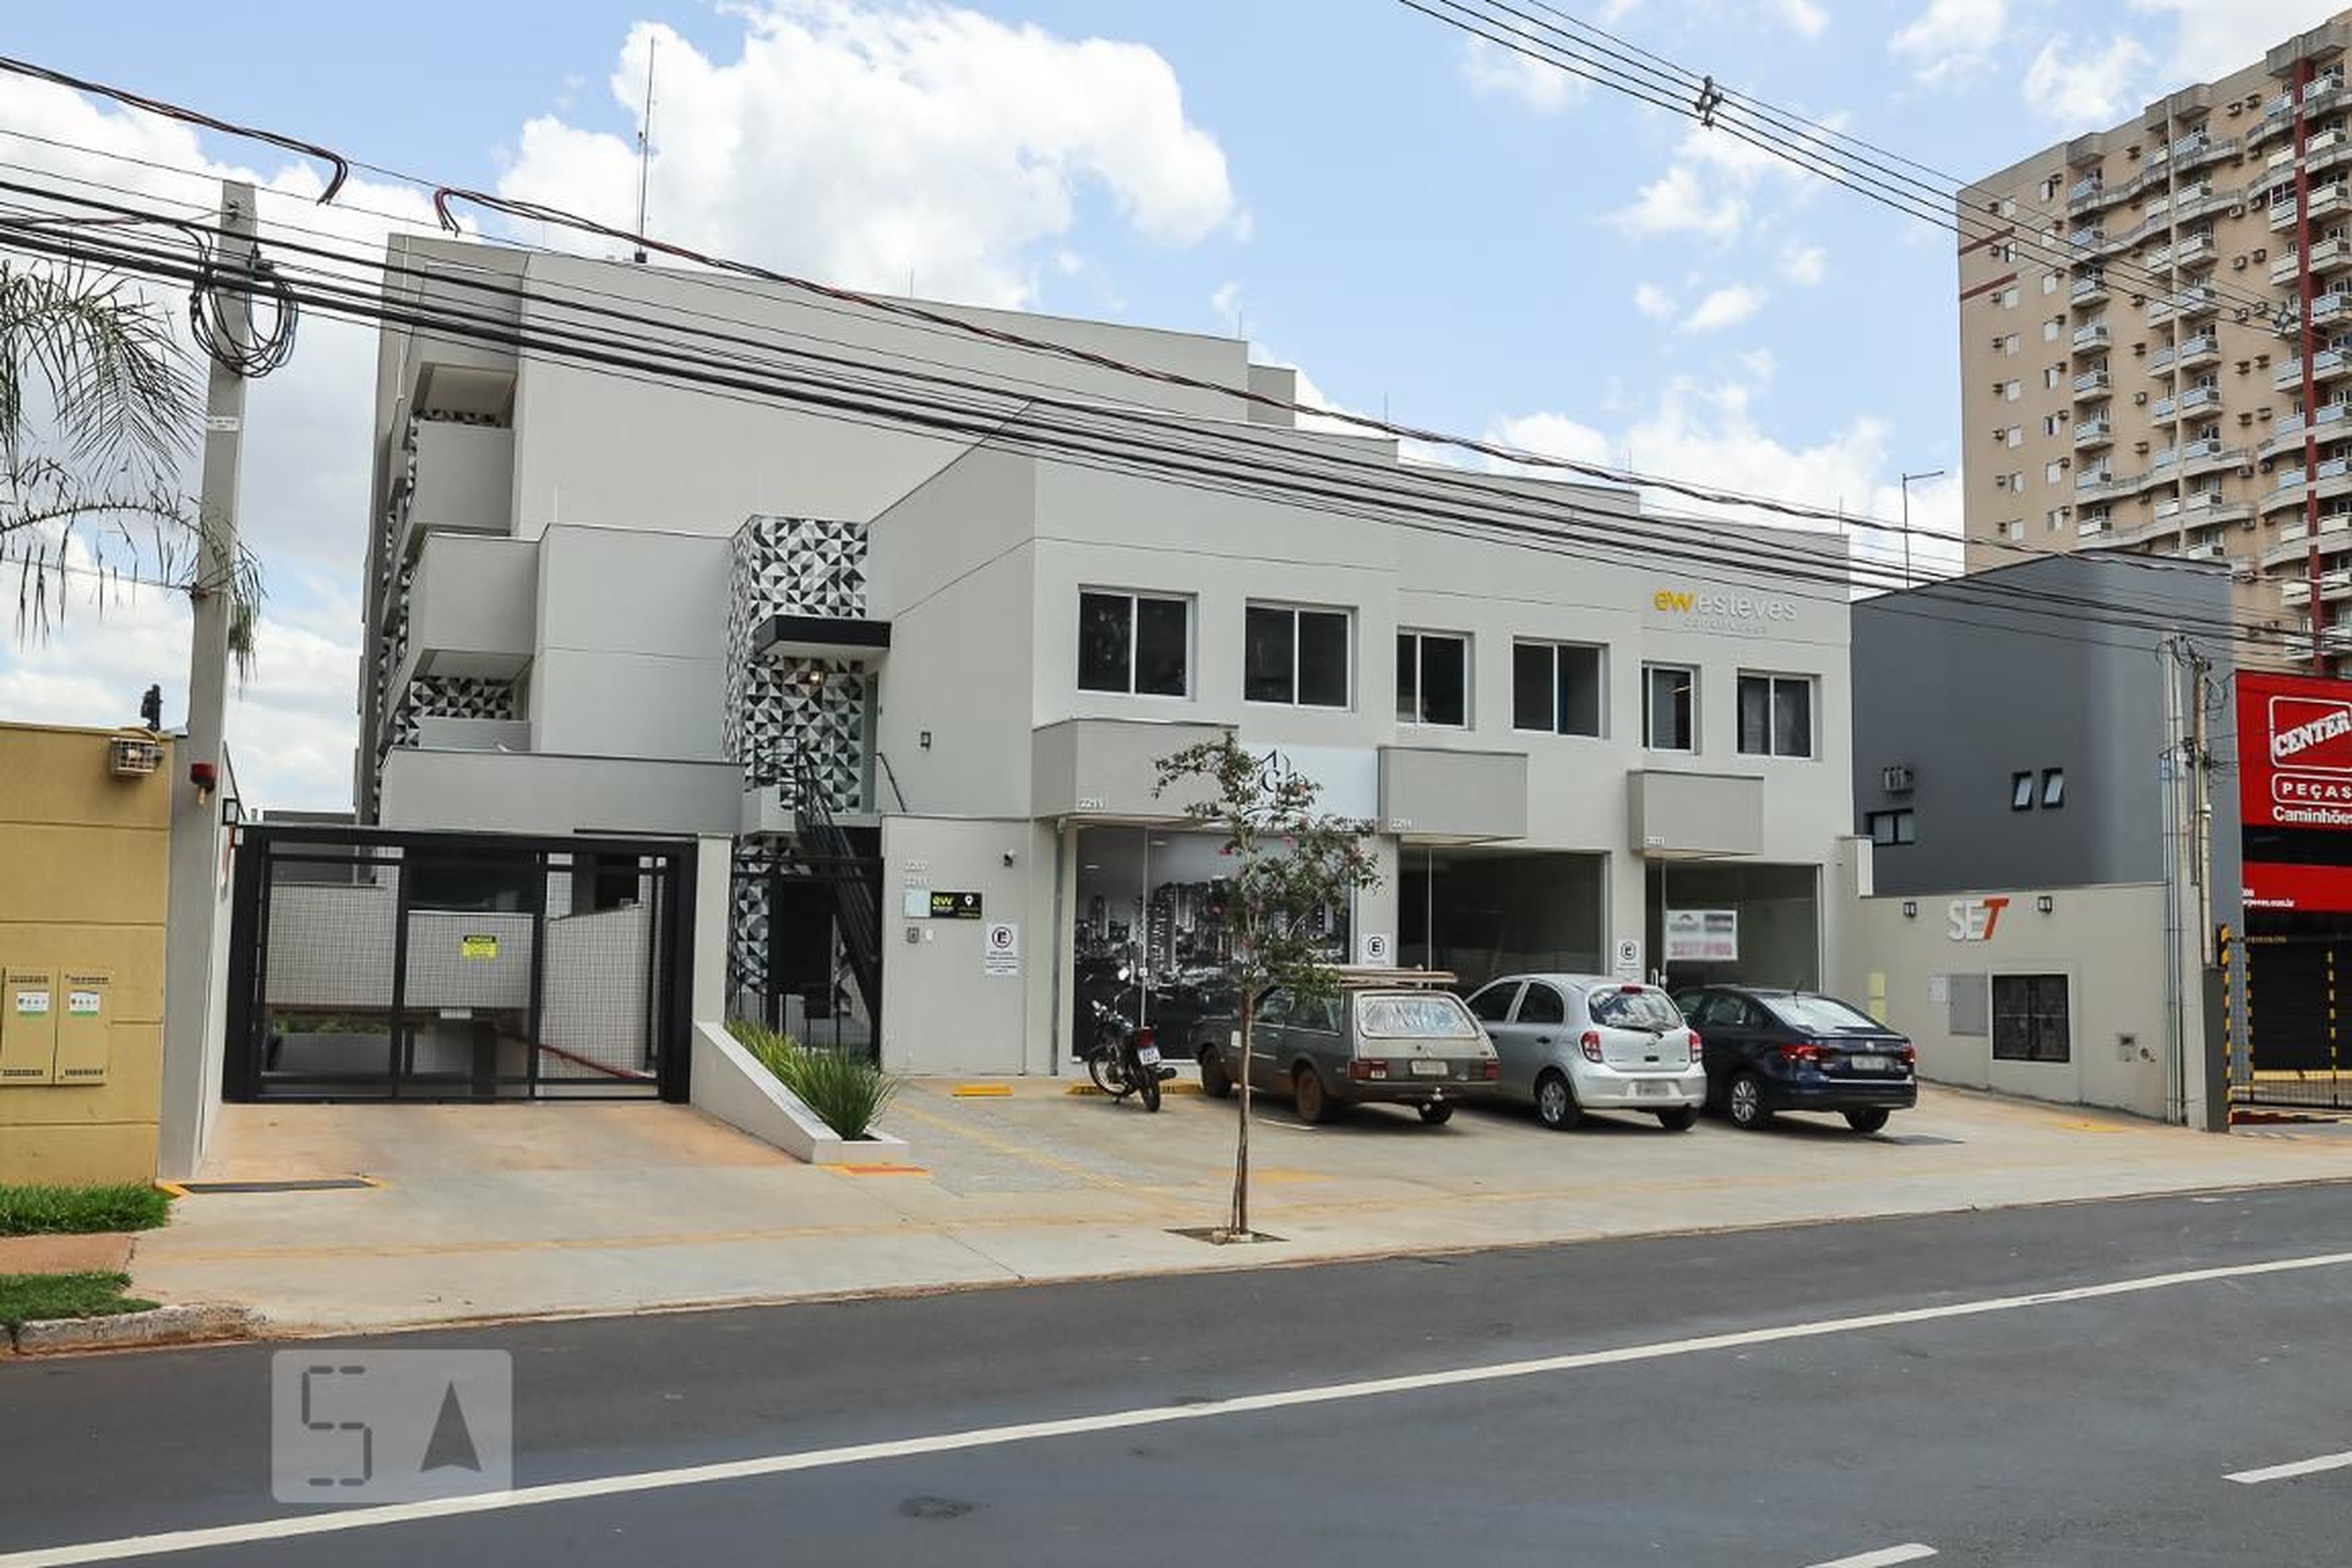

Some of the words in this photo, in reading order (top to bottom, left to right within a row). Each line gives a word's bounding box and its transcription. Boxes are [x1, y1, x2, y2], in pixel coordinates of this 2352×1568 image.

[1654, 587, 1694, 611] ew
[1697, 590, 1796, 620] esteves
[2283, 782, 2352, 799] PEÇAS
[1948, 898, 2010, 940] SET
